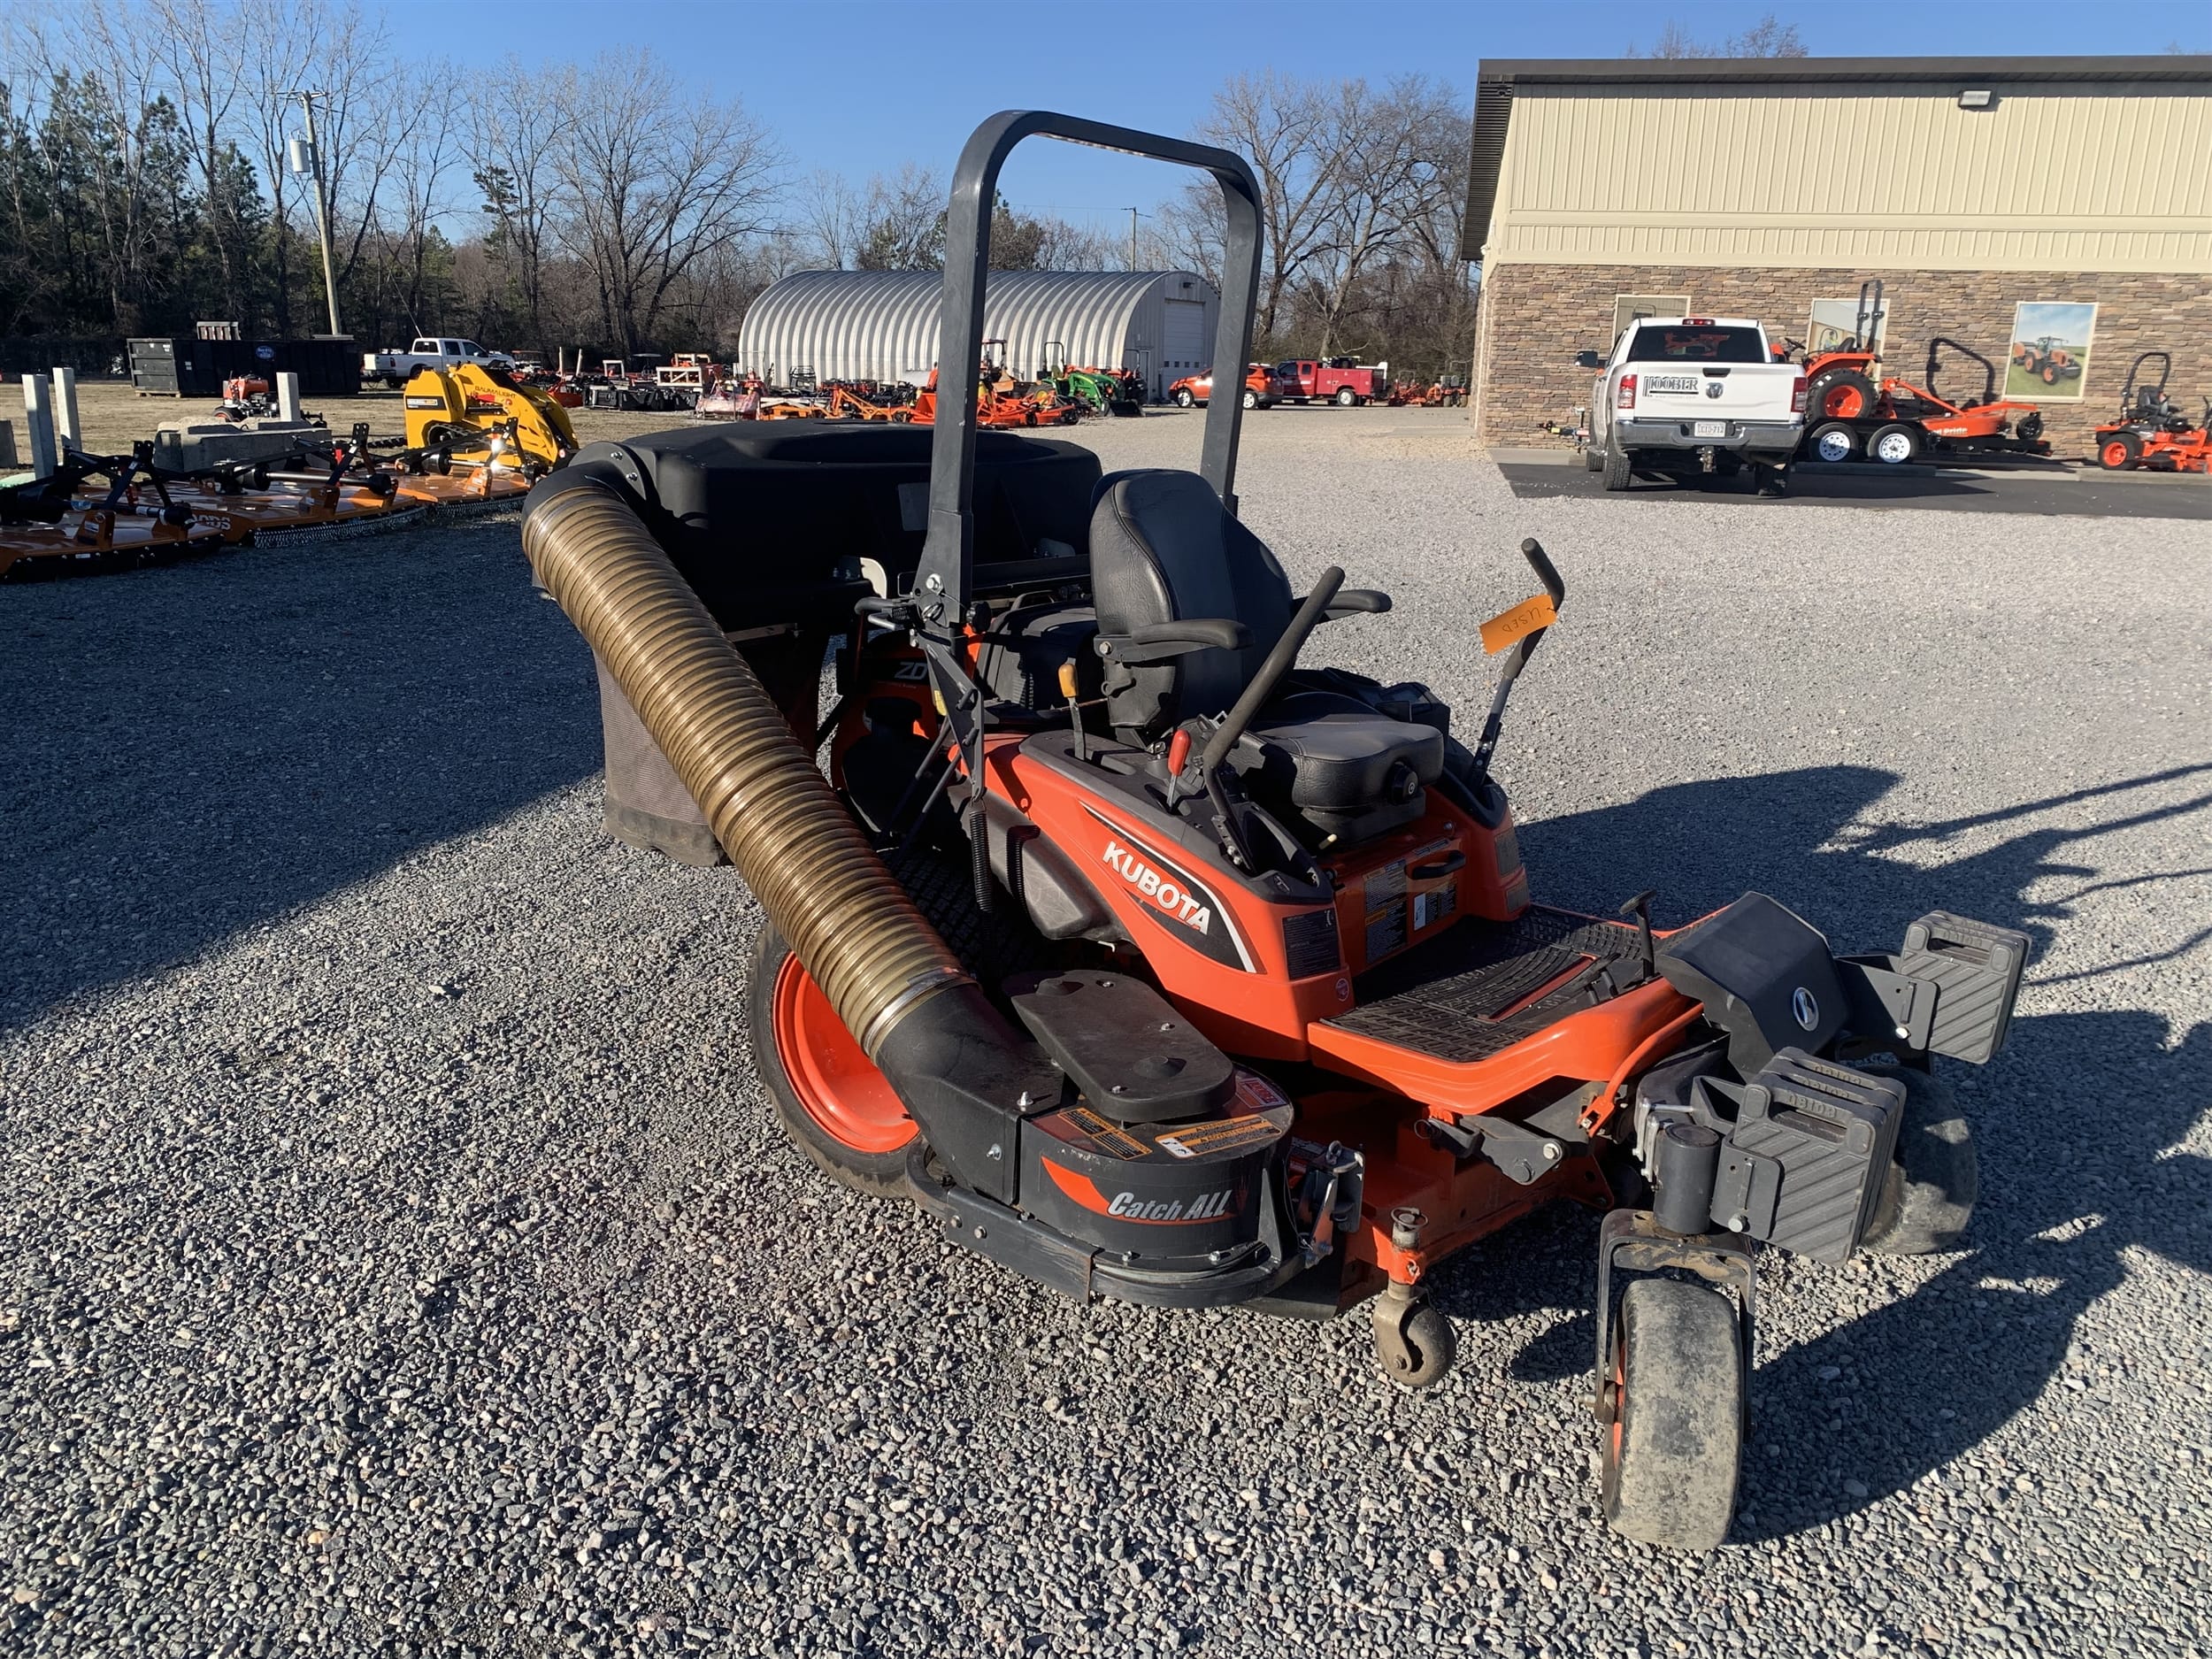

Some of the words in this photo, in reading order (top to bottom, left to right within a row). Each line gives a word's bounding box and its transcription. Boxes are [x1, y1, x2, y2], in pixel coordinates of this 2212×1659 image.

[1642, 376, 1699, 396] HOOBER
[1944, 426, 1969, 435] Pride
[1502, 607, 1542, 633] USED
[1102, 841, 1211, 935] KUBOTA
[1107, 1191, 1183, 1221] Catch
[1182, 1189, 1233, 1220] ALL
